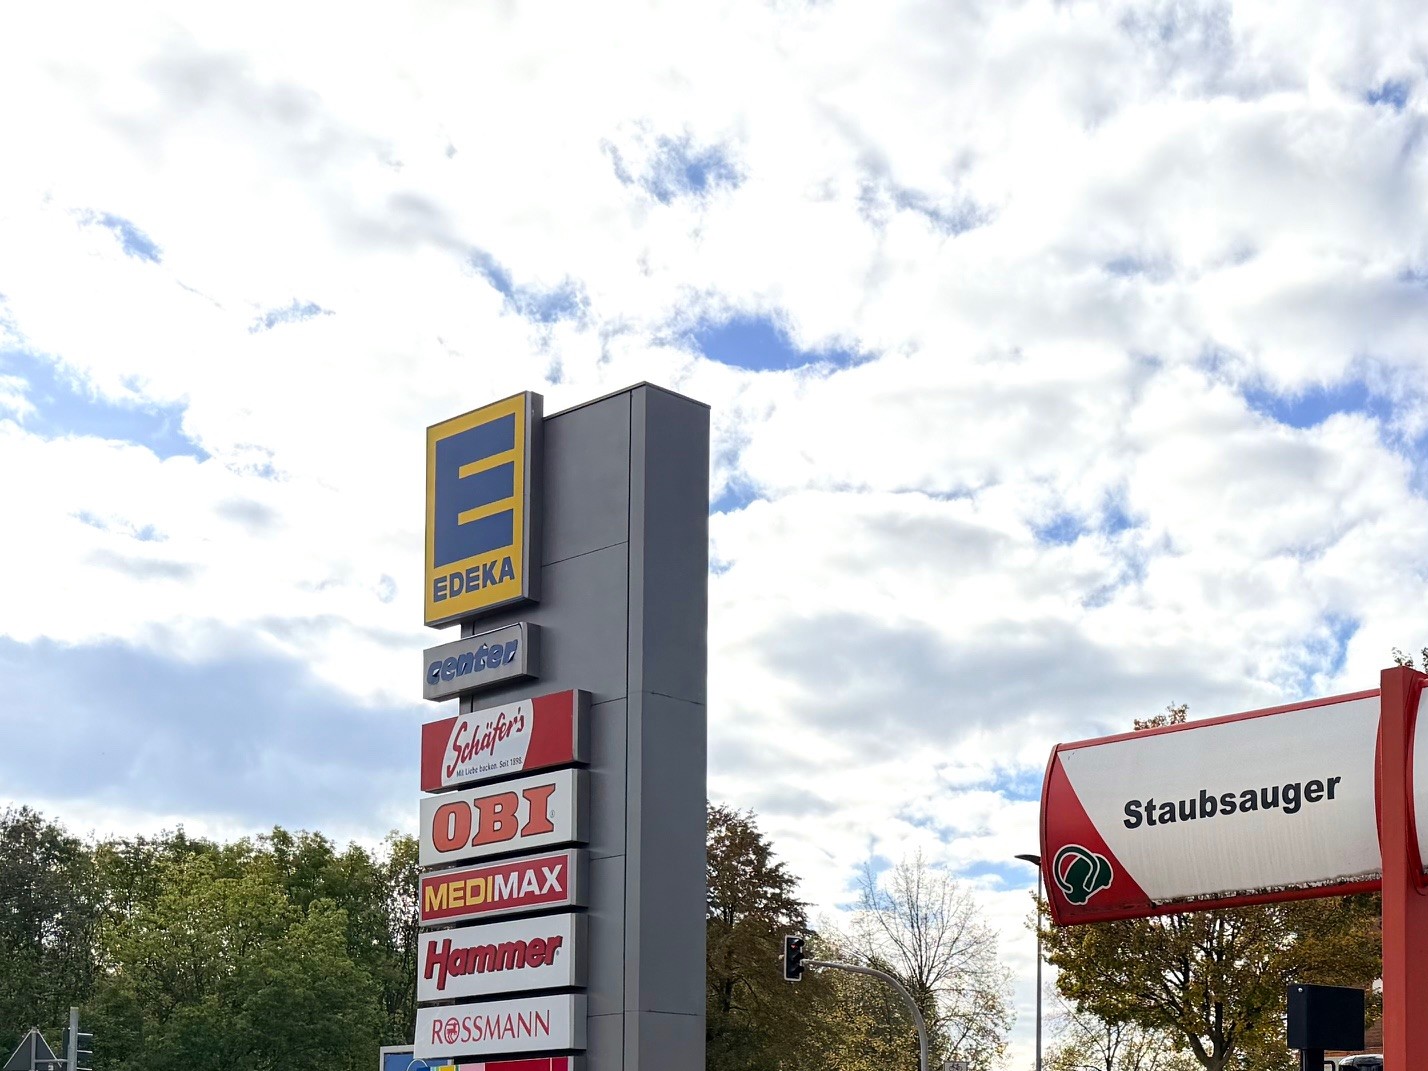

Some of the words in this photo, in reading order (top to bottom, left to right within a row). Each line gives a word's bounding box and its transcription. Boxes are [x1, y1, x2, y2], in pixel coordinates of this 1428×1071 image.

[434, 555, 515, 603] EDEKA
[426, 638, 518, 685] center
[447, 706, 525, 778] Schäfer's
[465, 766, 478, 776] Liebe
[499, 760, 509, 768] Seit
[432, 783, 556, 853] OBI
[1122, 774, 1341, 830] Staubsauger
[424, 863, 563, 913] MEDIMAX
[423, 934, 563, 991] Hammer
[431, 1009, 550, 1045] ROSSMANN
